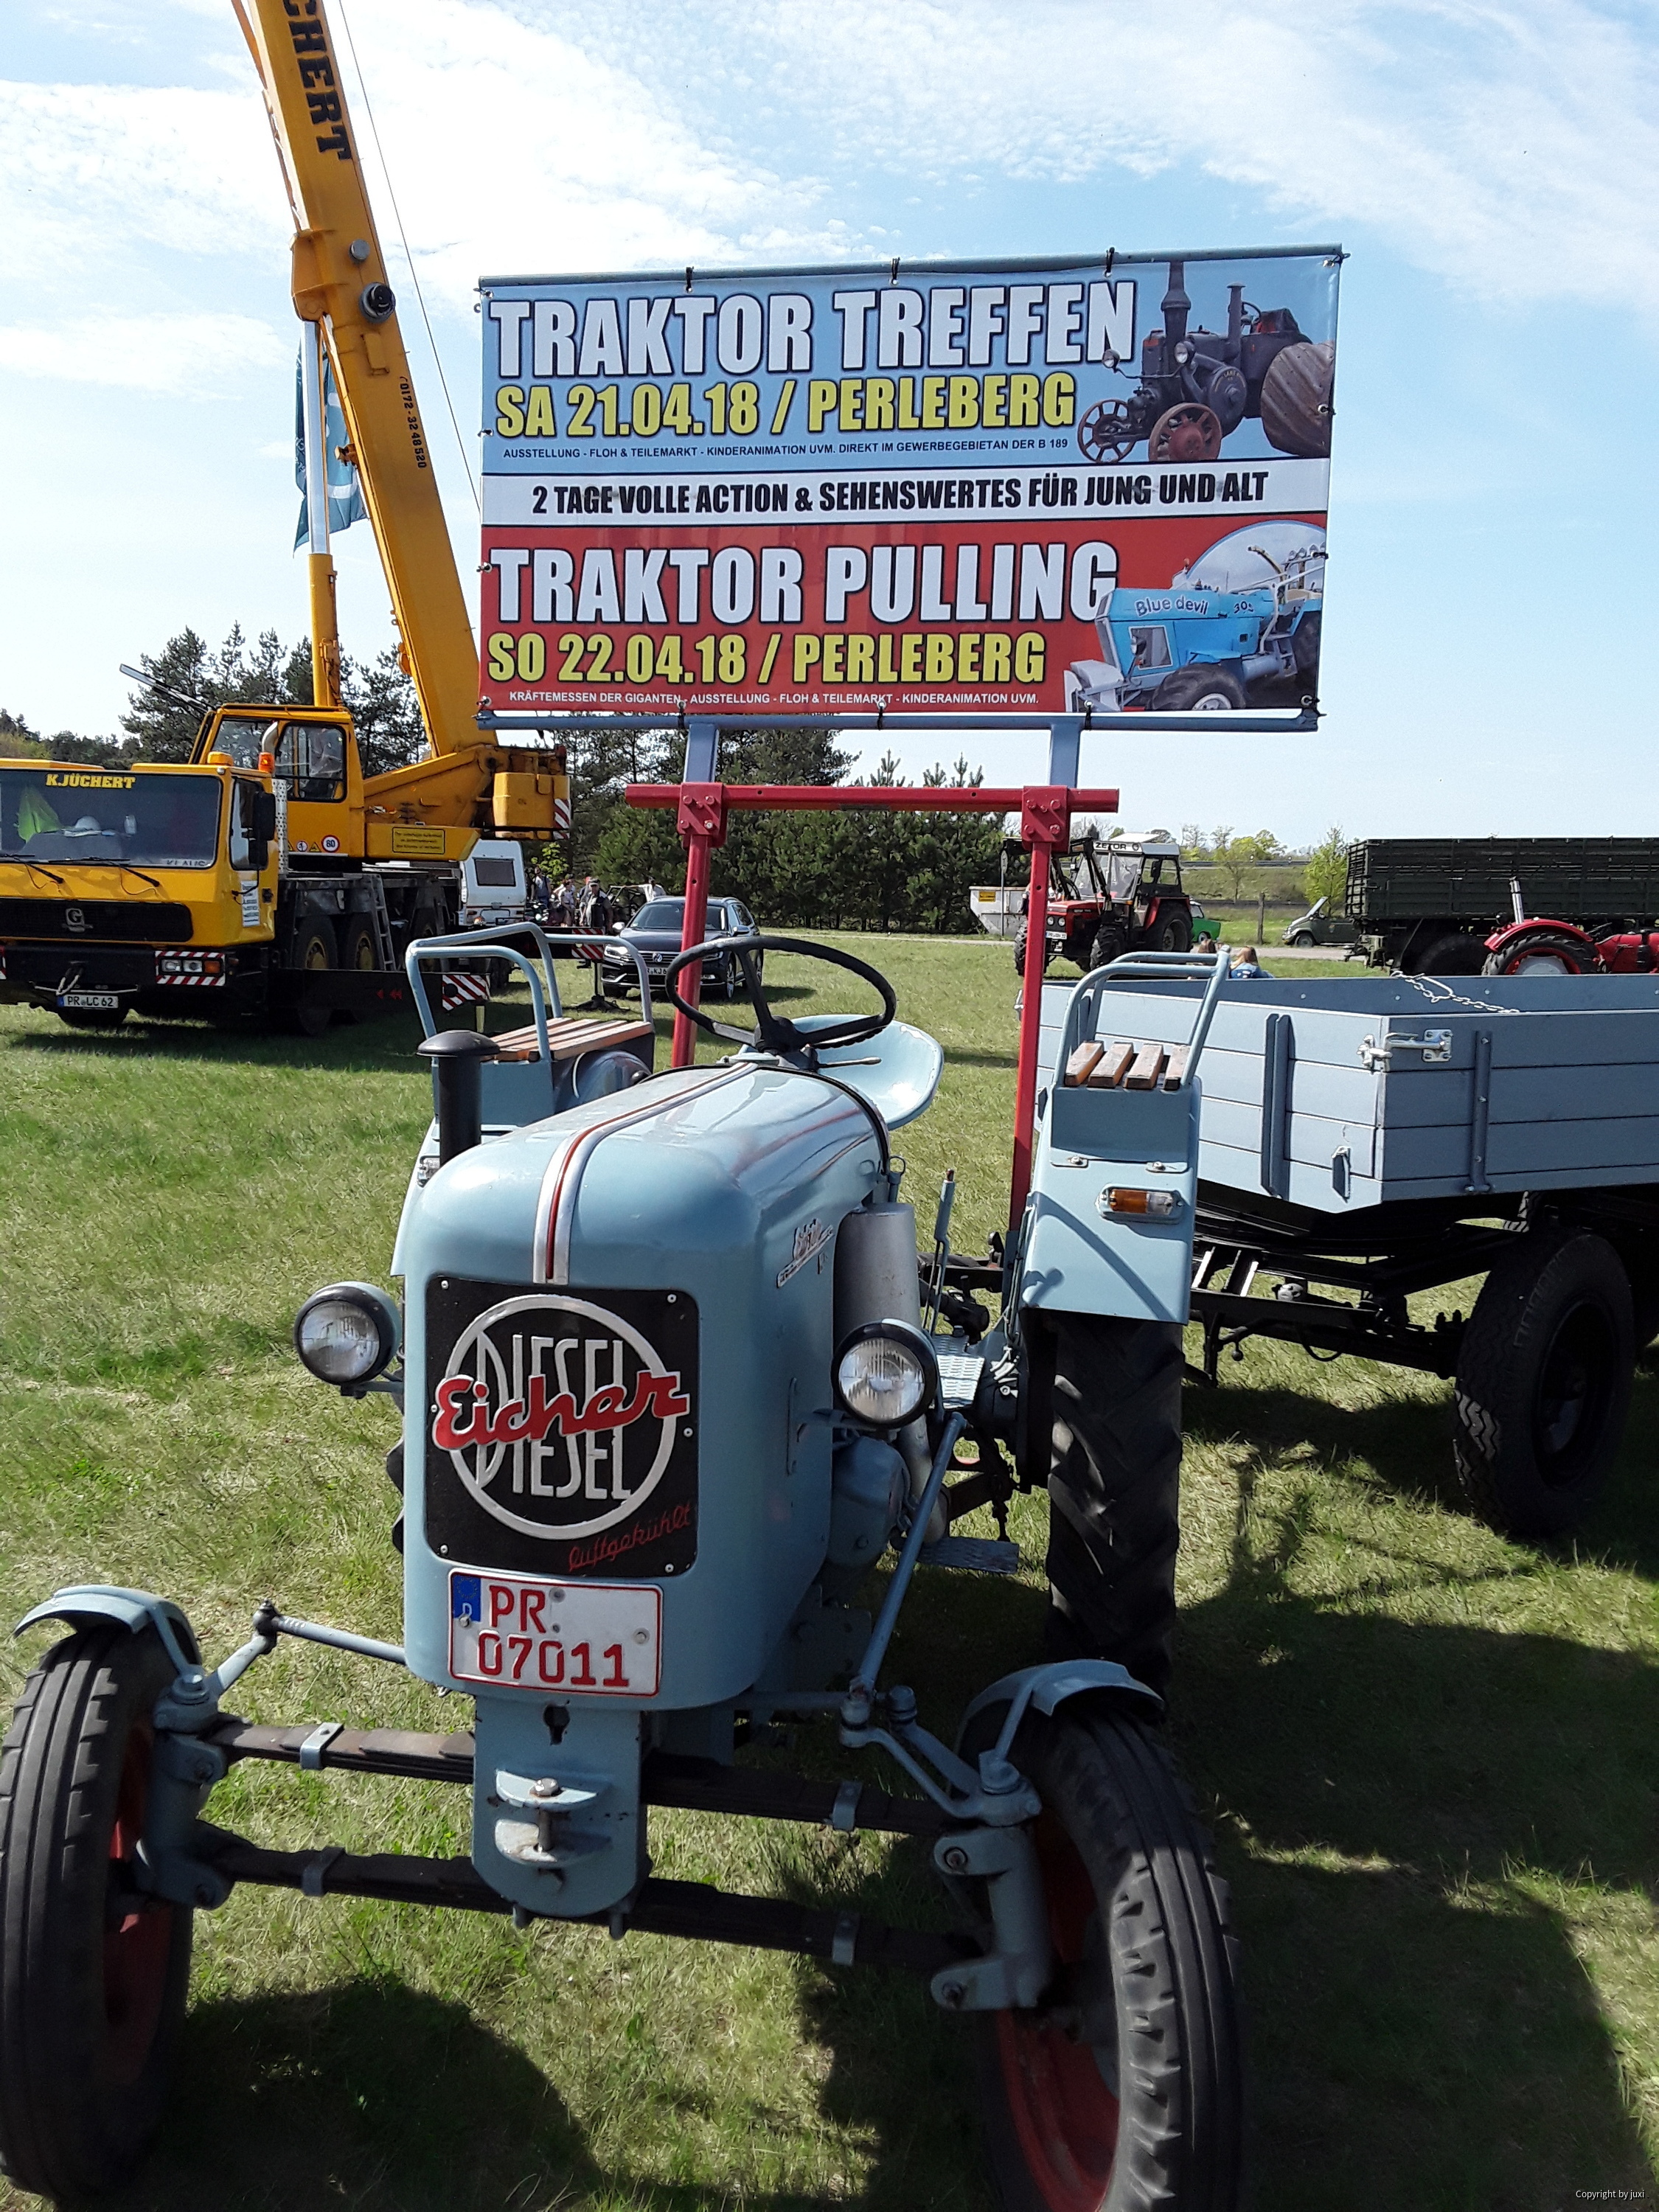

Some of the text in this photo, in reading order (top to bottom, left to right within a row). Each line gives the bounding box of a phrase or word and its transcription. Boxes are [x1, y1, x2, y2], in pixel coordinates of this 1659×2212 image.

[488, 281, 1136, 378] TRAKTOR TREFFEN
[495, 373, 1076, 437] SA 21.04.18 / PERLEBERG
[503, 448, 580, 459] AUSSTELLUNG
[589, 448, 618, 458] FLOH
[620, 448, 627, 458] &
[630, 447, 698, 457] TEILEMARKT
[707, 445, 805, 456] KINDERANIMATION
[810, 445, 836, 453] UVM.
[838, 442, 879, 453] DIREKT
[881, 442, 894, 452] IM
[1012, 439, 1034, 449] DER
[1038, 439, 1046, 448] B
[1049, 438, 1068, 448] 189
[532, 471, 1269, 514] 2 TAGE VOLLE ACTION & SEHENSWERTES FÜR JUNG UND ALT
[489, 541, 1118, 624] TRAKTOR PULLING
[1135, 597, 1171, 616] Blue
[1175, 596, 1208, 615] devil
[487, 631, 1046, 684] SO 22.04.18 / PERLEBERG
[509, 690, 597, 702] KRÄFTEMESSEN
[599, 692, 622, 703] DER
[625, 692, 681, 703] GIGANTEN
[690, 693, 771, 703] AUSSTELLUNG
[779, 693, 809, 703] FLOH
[812, 693, 820, 703] &
[823, 693, 893, 703] TEILEMARKT
[902, 693, 1008, 703] KINDERANIMATION
[1011, 693, 1039, 703] UVM.
[1095, 842, 1127, 850] ZETOR
[434, 1371, 690, 1450] Eicher
[489, 1585, 546, 1634] PR
[478, 1630, 629, 1688] 07011
